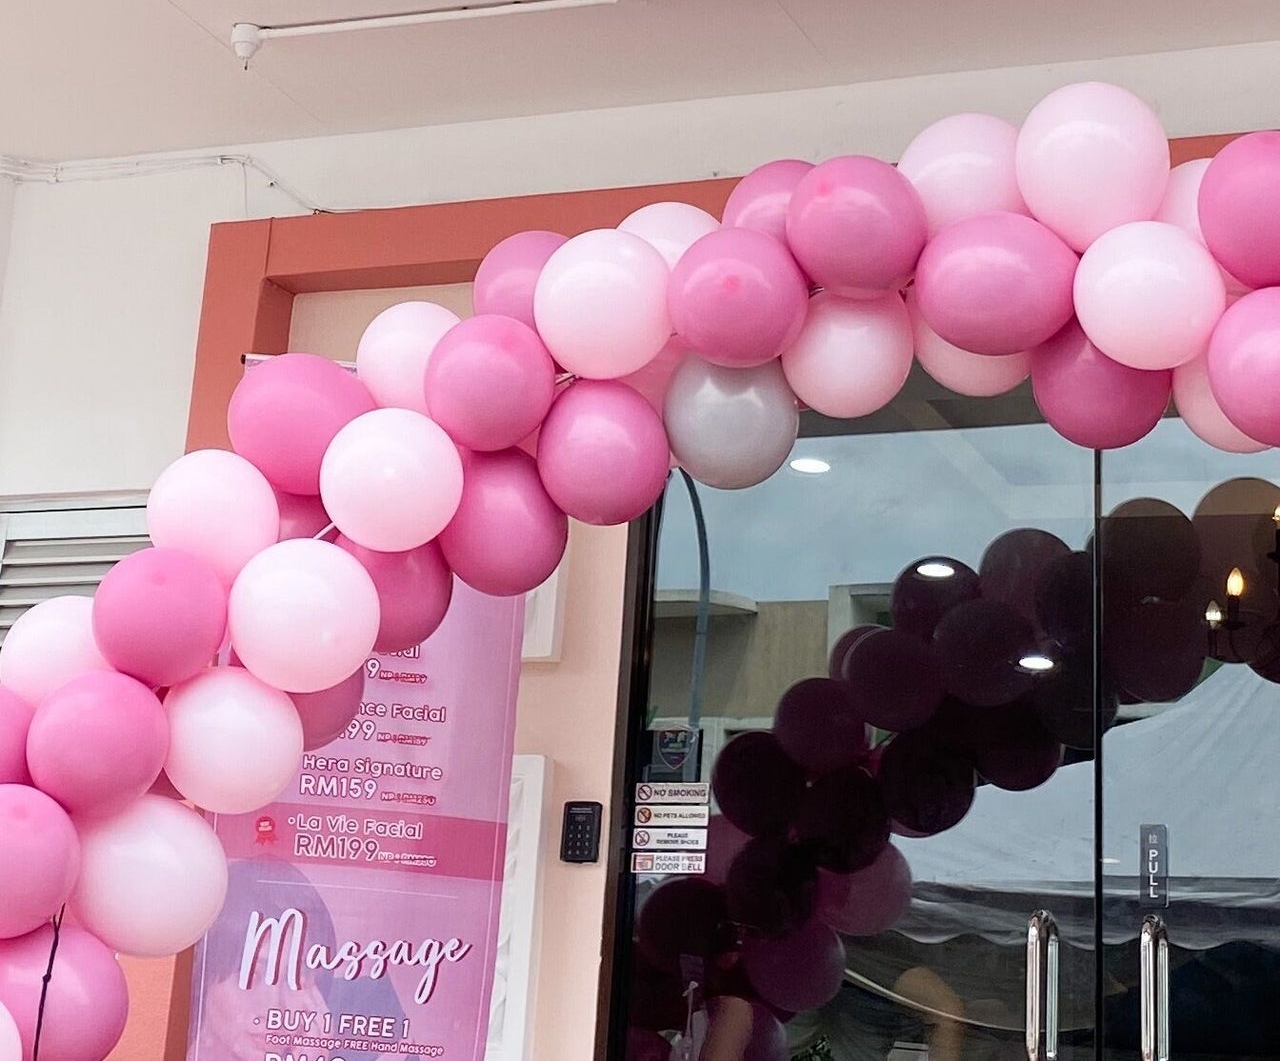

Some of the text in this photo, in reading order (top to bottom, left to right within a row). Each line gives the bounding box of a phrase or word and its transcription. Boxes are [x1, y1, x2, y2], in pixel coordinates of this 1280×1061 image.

[391, 704, 447, 722] Facial
[302, 754, 444, 781] Hera Signature
[299, 773, 378, 800] RM159
[654, 788, 707, 797] NO SMOKING
[297, 813, 424, 840] La Vie Facial
[294, 834, 379, 862] RM199
[655, 863, 702, 871] DOOR BELL
[1148, 849, 1159, 898] PULL
[238, 907, 474, 1005] Massage
[266, 1008, 411, 1039] BUY 1 FREE 1
[265, 1034, 444, 1057] Foot Massage FREE Hand Massage
